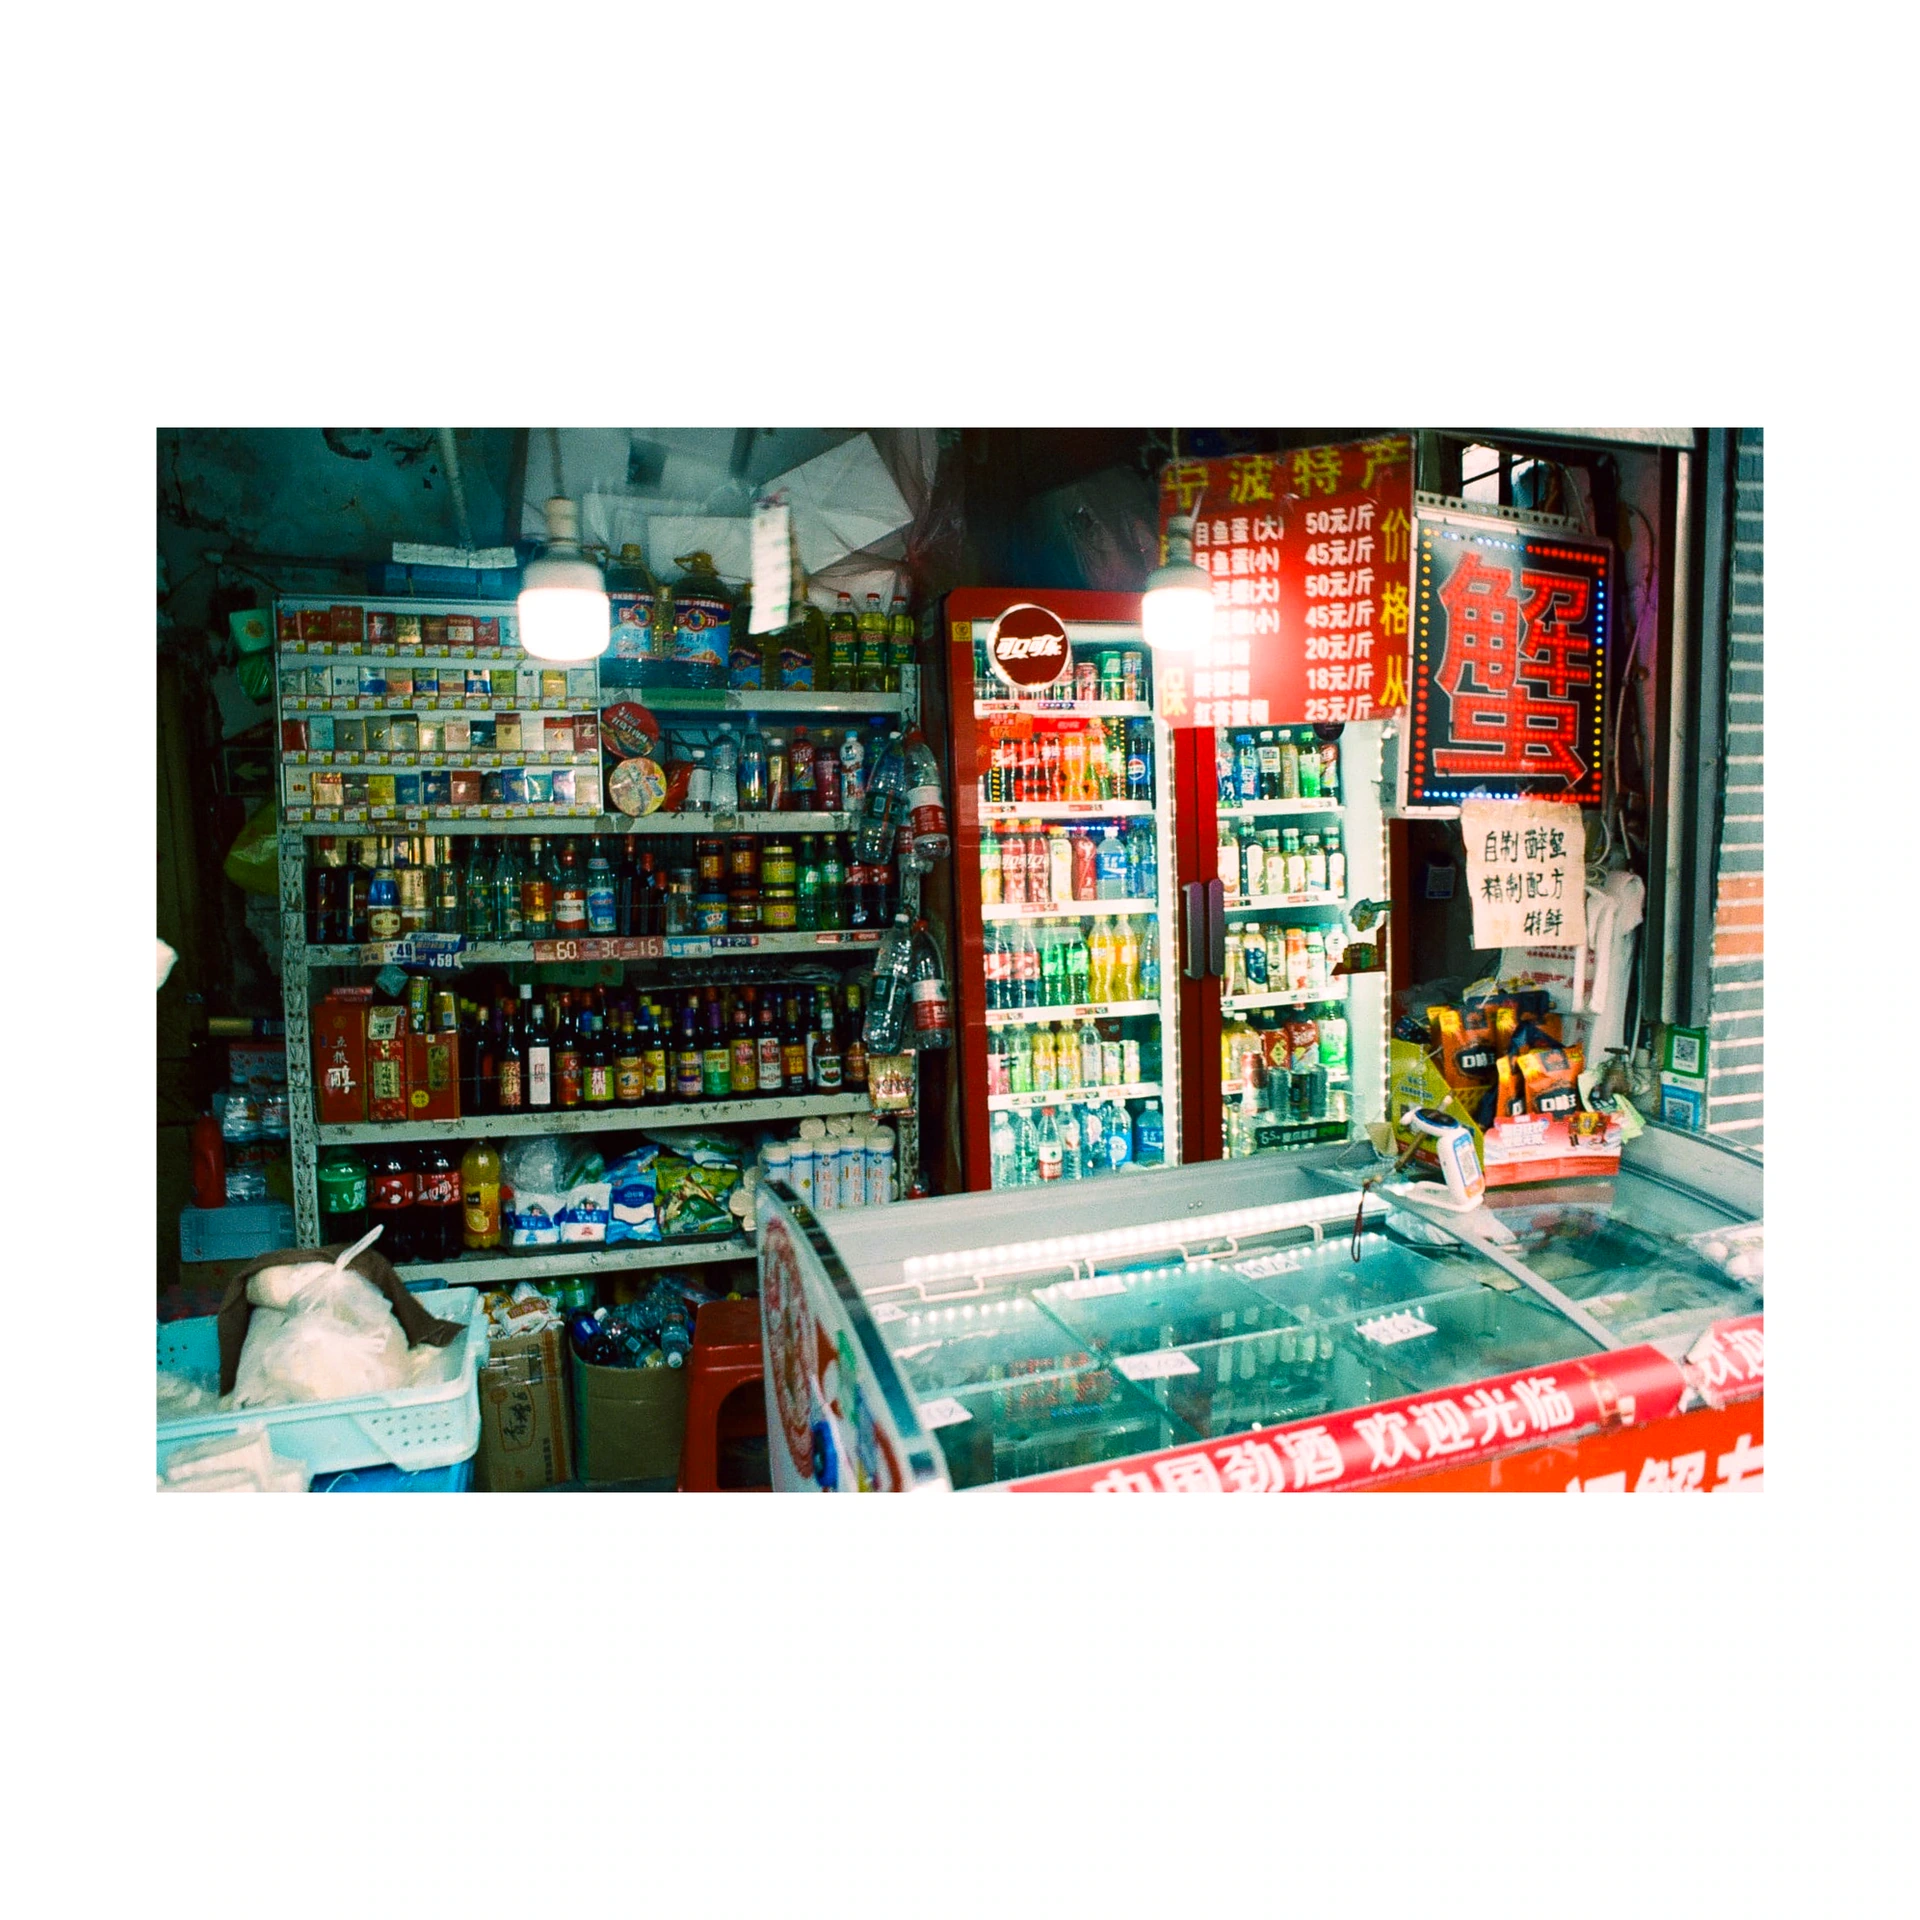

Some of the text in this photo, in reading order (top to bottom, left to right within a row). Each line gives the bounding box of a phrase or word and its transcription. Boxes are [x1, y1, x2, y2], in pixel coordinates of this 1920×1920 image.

[1164, 438, 1410, 509] 宁波特产
[1305, 503, 1376, 536] 50元/斤
[1304, 535, 1376, 567] 45元/斤
[1305, 567, 1376, 599] 50元/斤
[1304, 599, 1376, 630] 45元/斤
[996, 634, 1065, 661] 可口可乐
[1304, 631, 1375, 661] 20元/斤
[1306, 662, 1375, 692] 18元/斤
[1433, 549, 1592, 787] 蟹
[1304, 693, 1375, 722] 25元/斤
[1481, 868, 1564, 904] 精制配方
[1523, 908, 1564, 937] 特鲜
[1353, 1376, 1576, 1472] 欢迎光临
